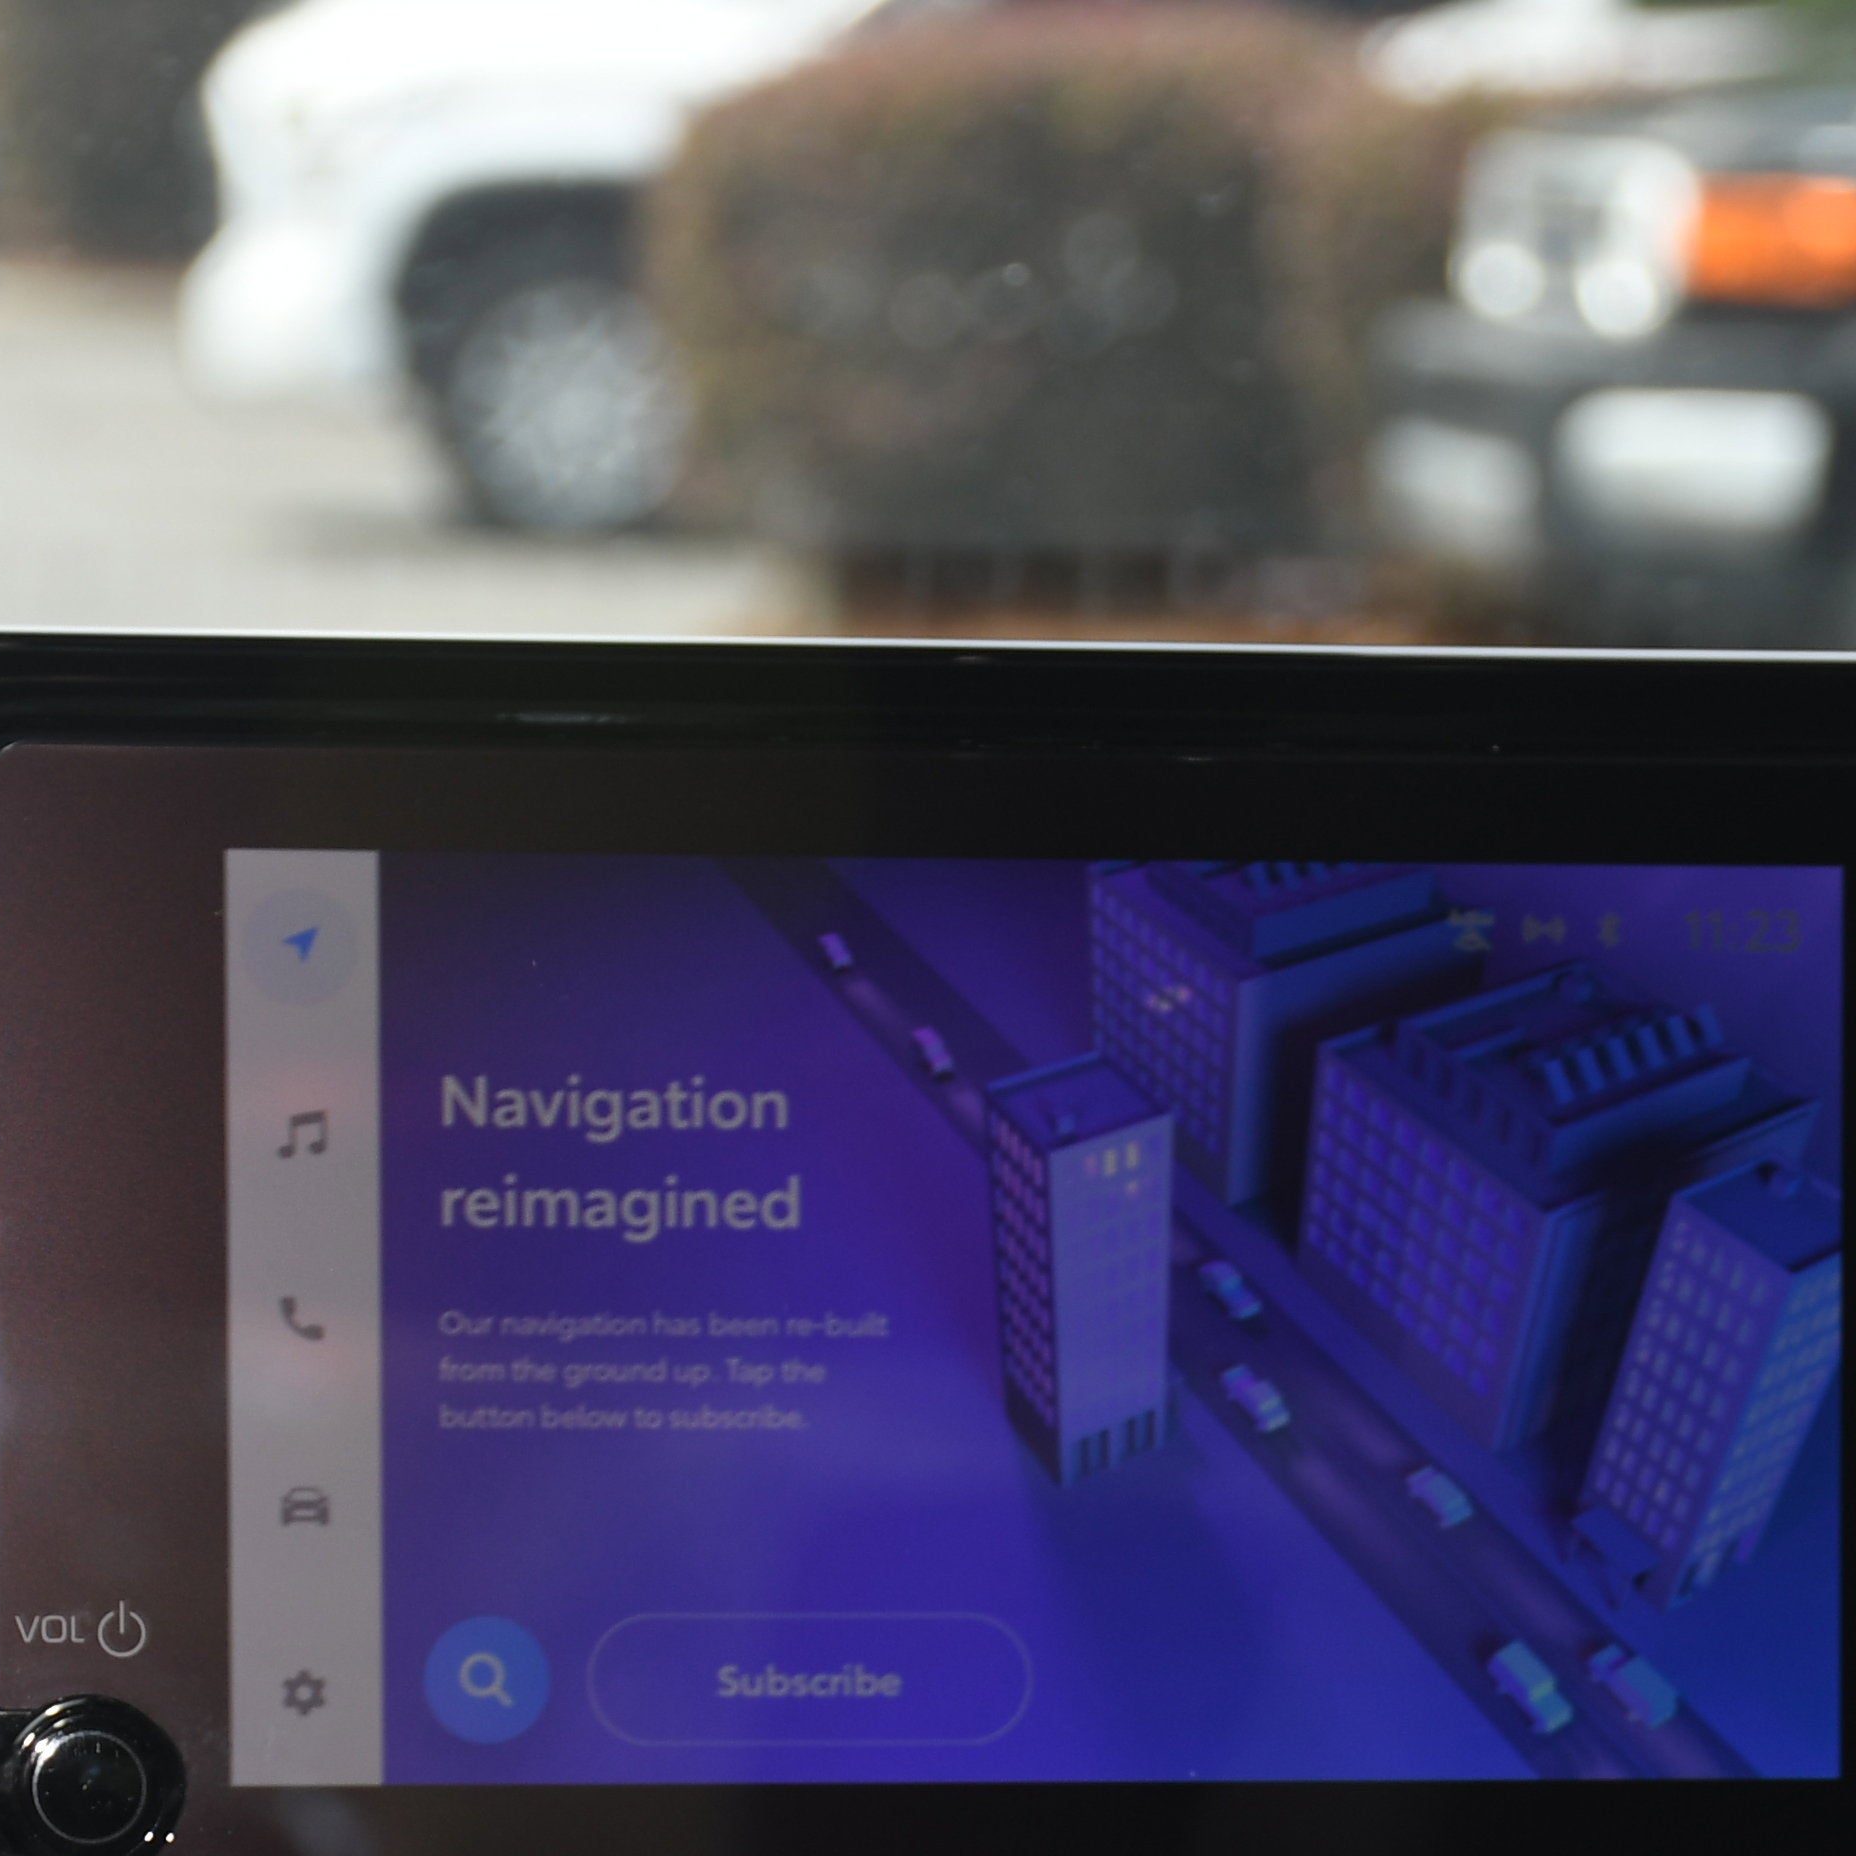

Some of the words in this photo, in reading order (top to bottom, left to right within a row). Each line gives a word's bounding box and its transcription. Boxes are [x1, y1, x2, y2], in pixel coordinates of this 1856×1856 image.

[440, 1076, 789, 1143] Navigation
[439, 1174, 803, 1243] reimagined
[439, 1313, 492, 1338] Our
[500, 1310, 645, 1342] navigation
[653, 1311, 699, 1338] has
[708, 1311, 779, 1338] been
[786, 1311, 889, 1338] re-built
[439, 1357, 503, 1384] from
[511, 1358, 556, 1384] the
[563, 1358, 665, 1388] ground
[672, 1362, 715, 1388] up.
[726, 1358, 772, 1388] Tap
[780, 1358, 826, 1384] the
[439, 1404, 533, 1430] button
[541, 1404, 625, 1430] below
[633, 1406, 662, 1430] to
[671, 1404, 809, 1430] subscribe.
[15, 1615, 85, 1645] VOL
[717, 1664, 903, 1699] Subscribe
